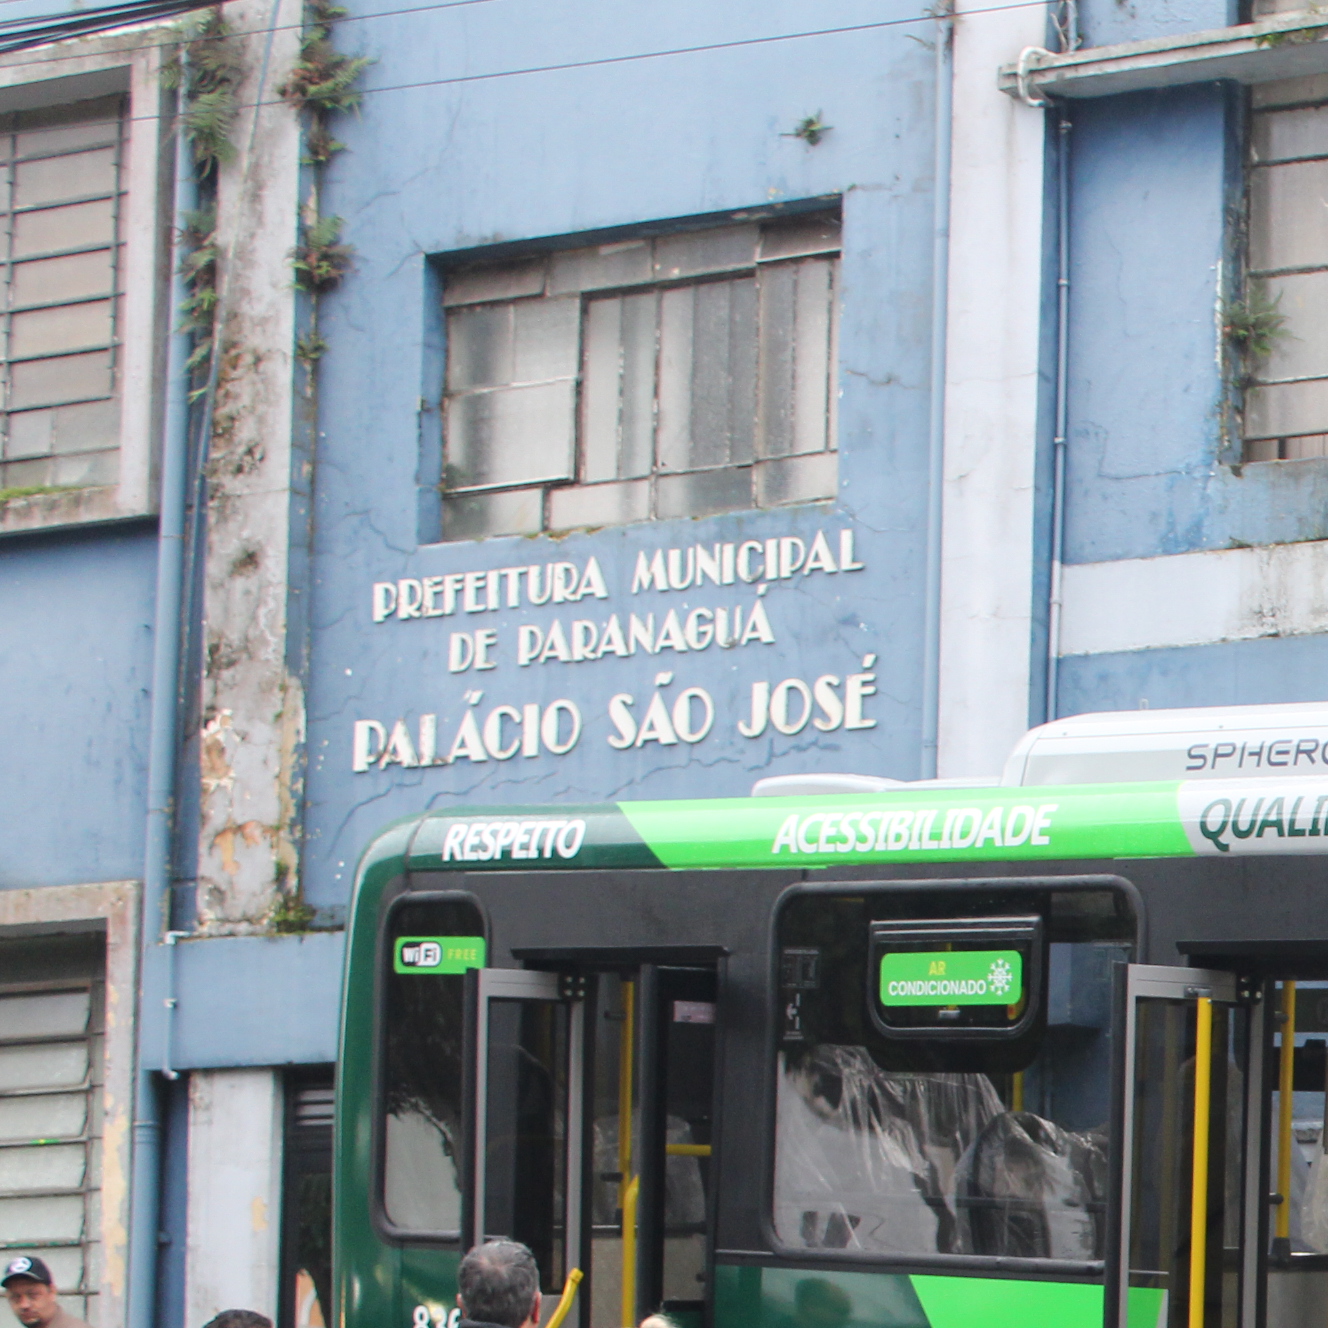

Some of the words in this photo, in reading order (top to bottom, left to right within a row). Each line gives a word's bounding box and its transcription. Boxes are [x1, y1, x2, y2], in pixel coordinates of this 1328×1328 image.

[373, 556, 608, 623] PREFEITURA
[631, 529, 865, 594] MUNICIPAL
[449, 630, 497, 673] DE
[517, 585, 776, 666] PARANAGUÁ
[353, 690, 582, 772] PALÁCIO
[607, 671, 715, 750] SÃO
[738, 654, 879, 739] JOSÉ
[442, 818, 585, 863] RESPEITO
[772, 803, 1059, 856] ACESSIBILIDADE
[447, 949, 477, 960] FREE
[929, 960, 947, 977] AR
[888, 979, 988, 997] CONDICIONADO
